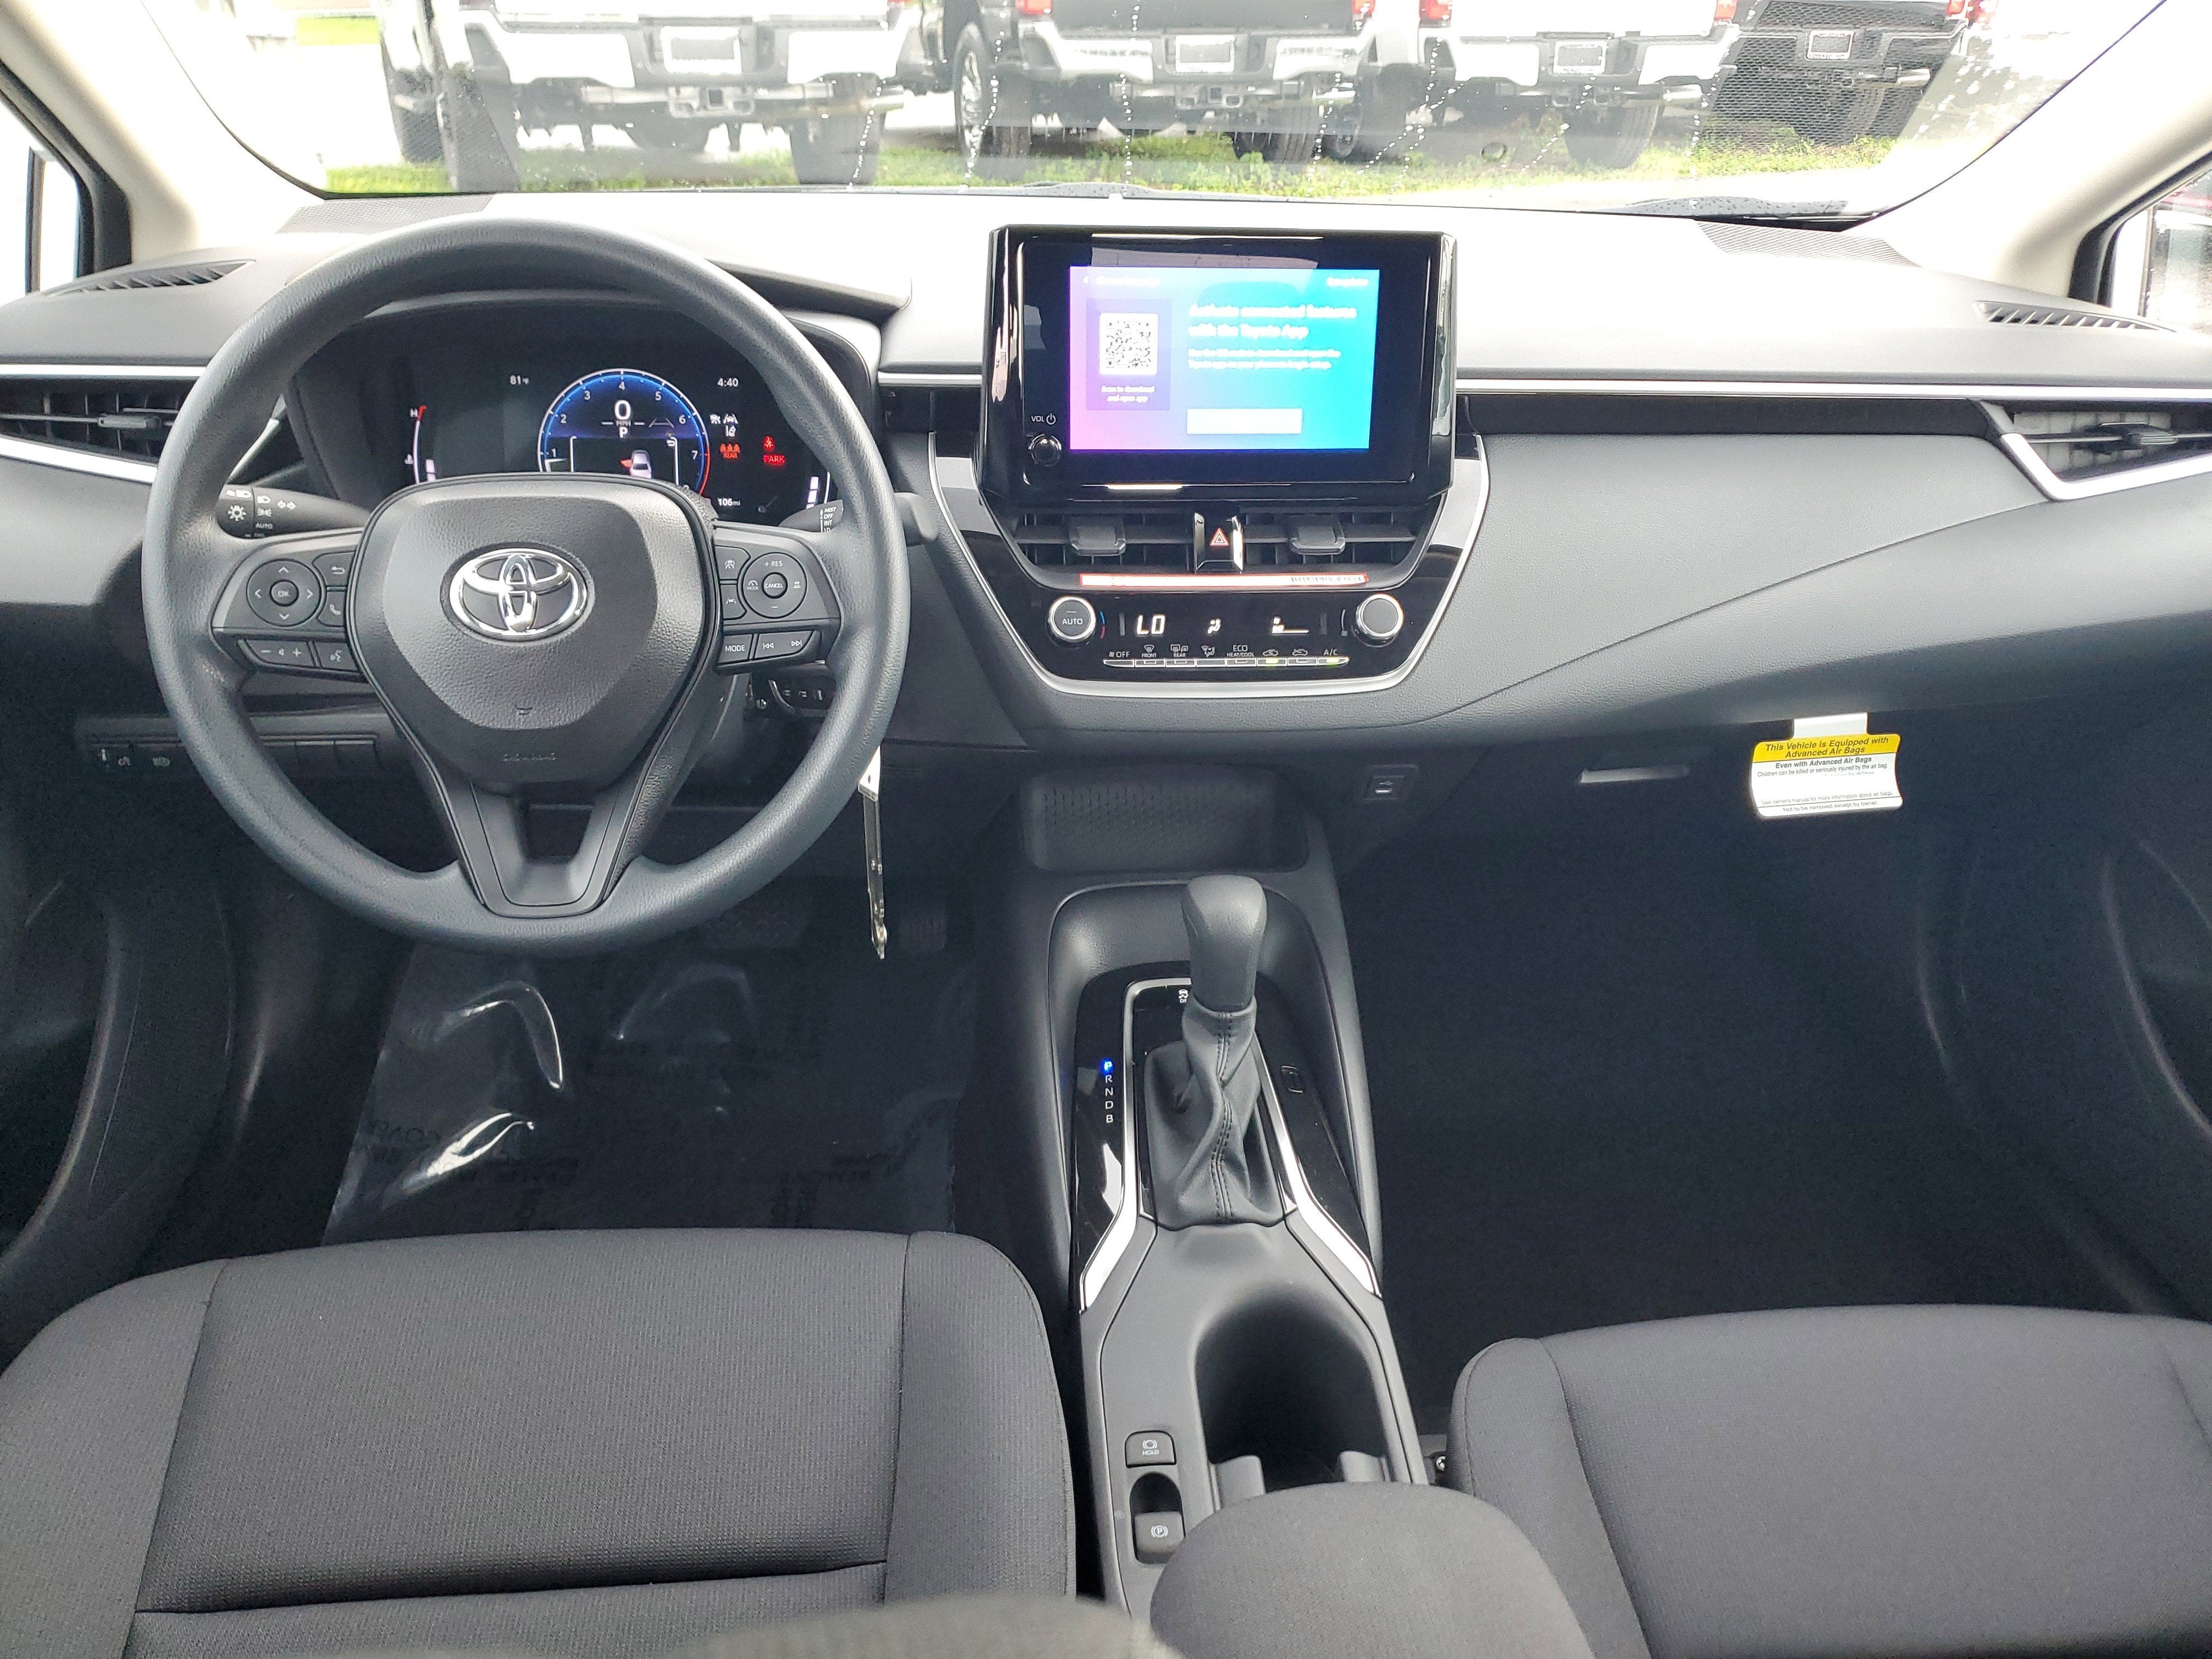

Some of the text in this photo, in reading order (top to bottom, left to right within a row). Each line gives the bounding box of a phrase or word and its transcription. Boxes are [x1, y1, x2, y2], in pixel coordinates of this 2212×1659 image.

[619, 382, 625, 390] 4
[718, 377, 739, 387] 4:40
[584, 390, 590, 400] 3
[655, 391, 662, 400] 5
[615, 400, 631, 420] 0
[560, 413, 567, 424] 2
[679, 416, 686, 424] 6
[619, 426, 628, 438] P
[551, 448, 556, 458] 1
[691, 450, 698, 459] 7
[763, 454, 786, 464] PARK
[1787, 741, 1816, 750] Vehicle
[1829, 738, 1870, 748] Equipped
[1785, 749, 1827, 758] Advanced
[1104, 1061, 1113, 1070] P
[1105, 1075, 1113, 1084] R
[1105, 1087, 1113, 1096] N
[1105, 1101, 1114, 1109] D
[1106, 1115, 1113, 1123] B
